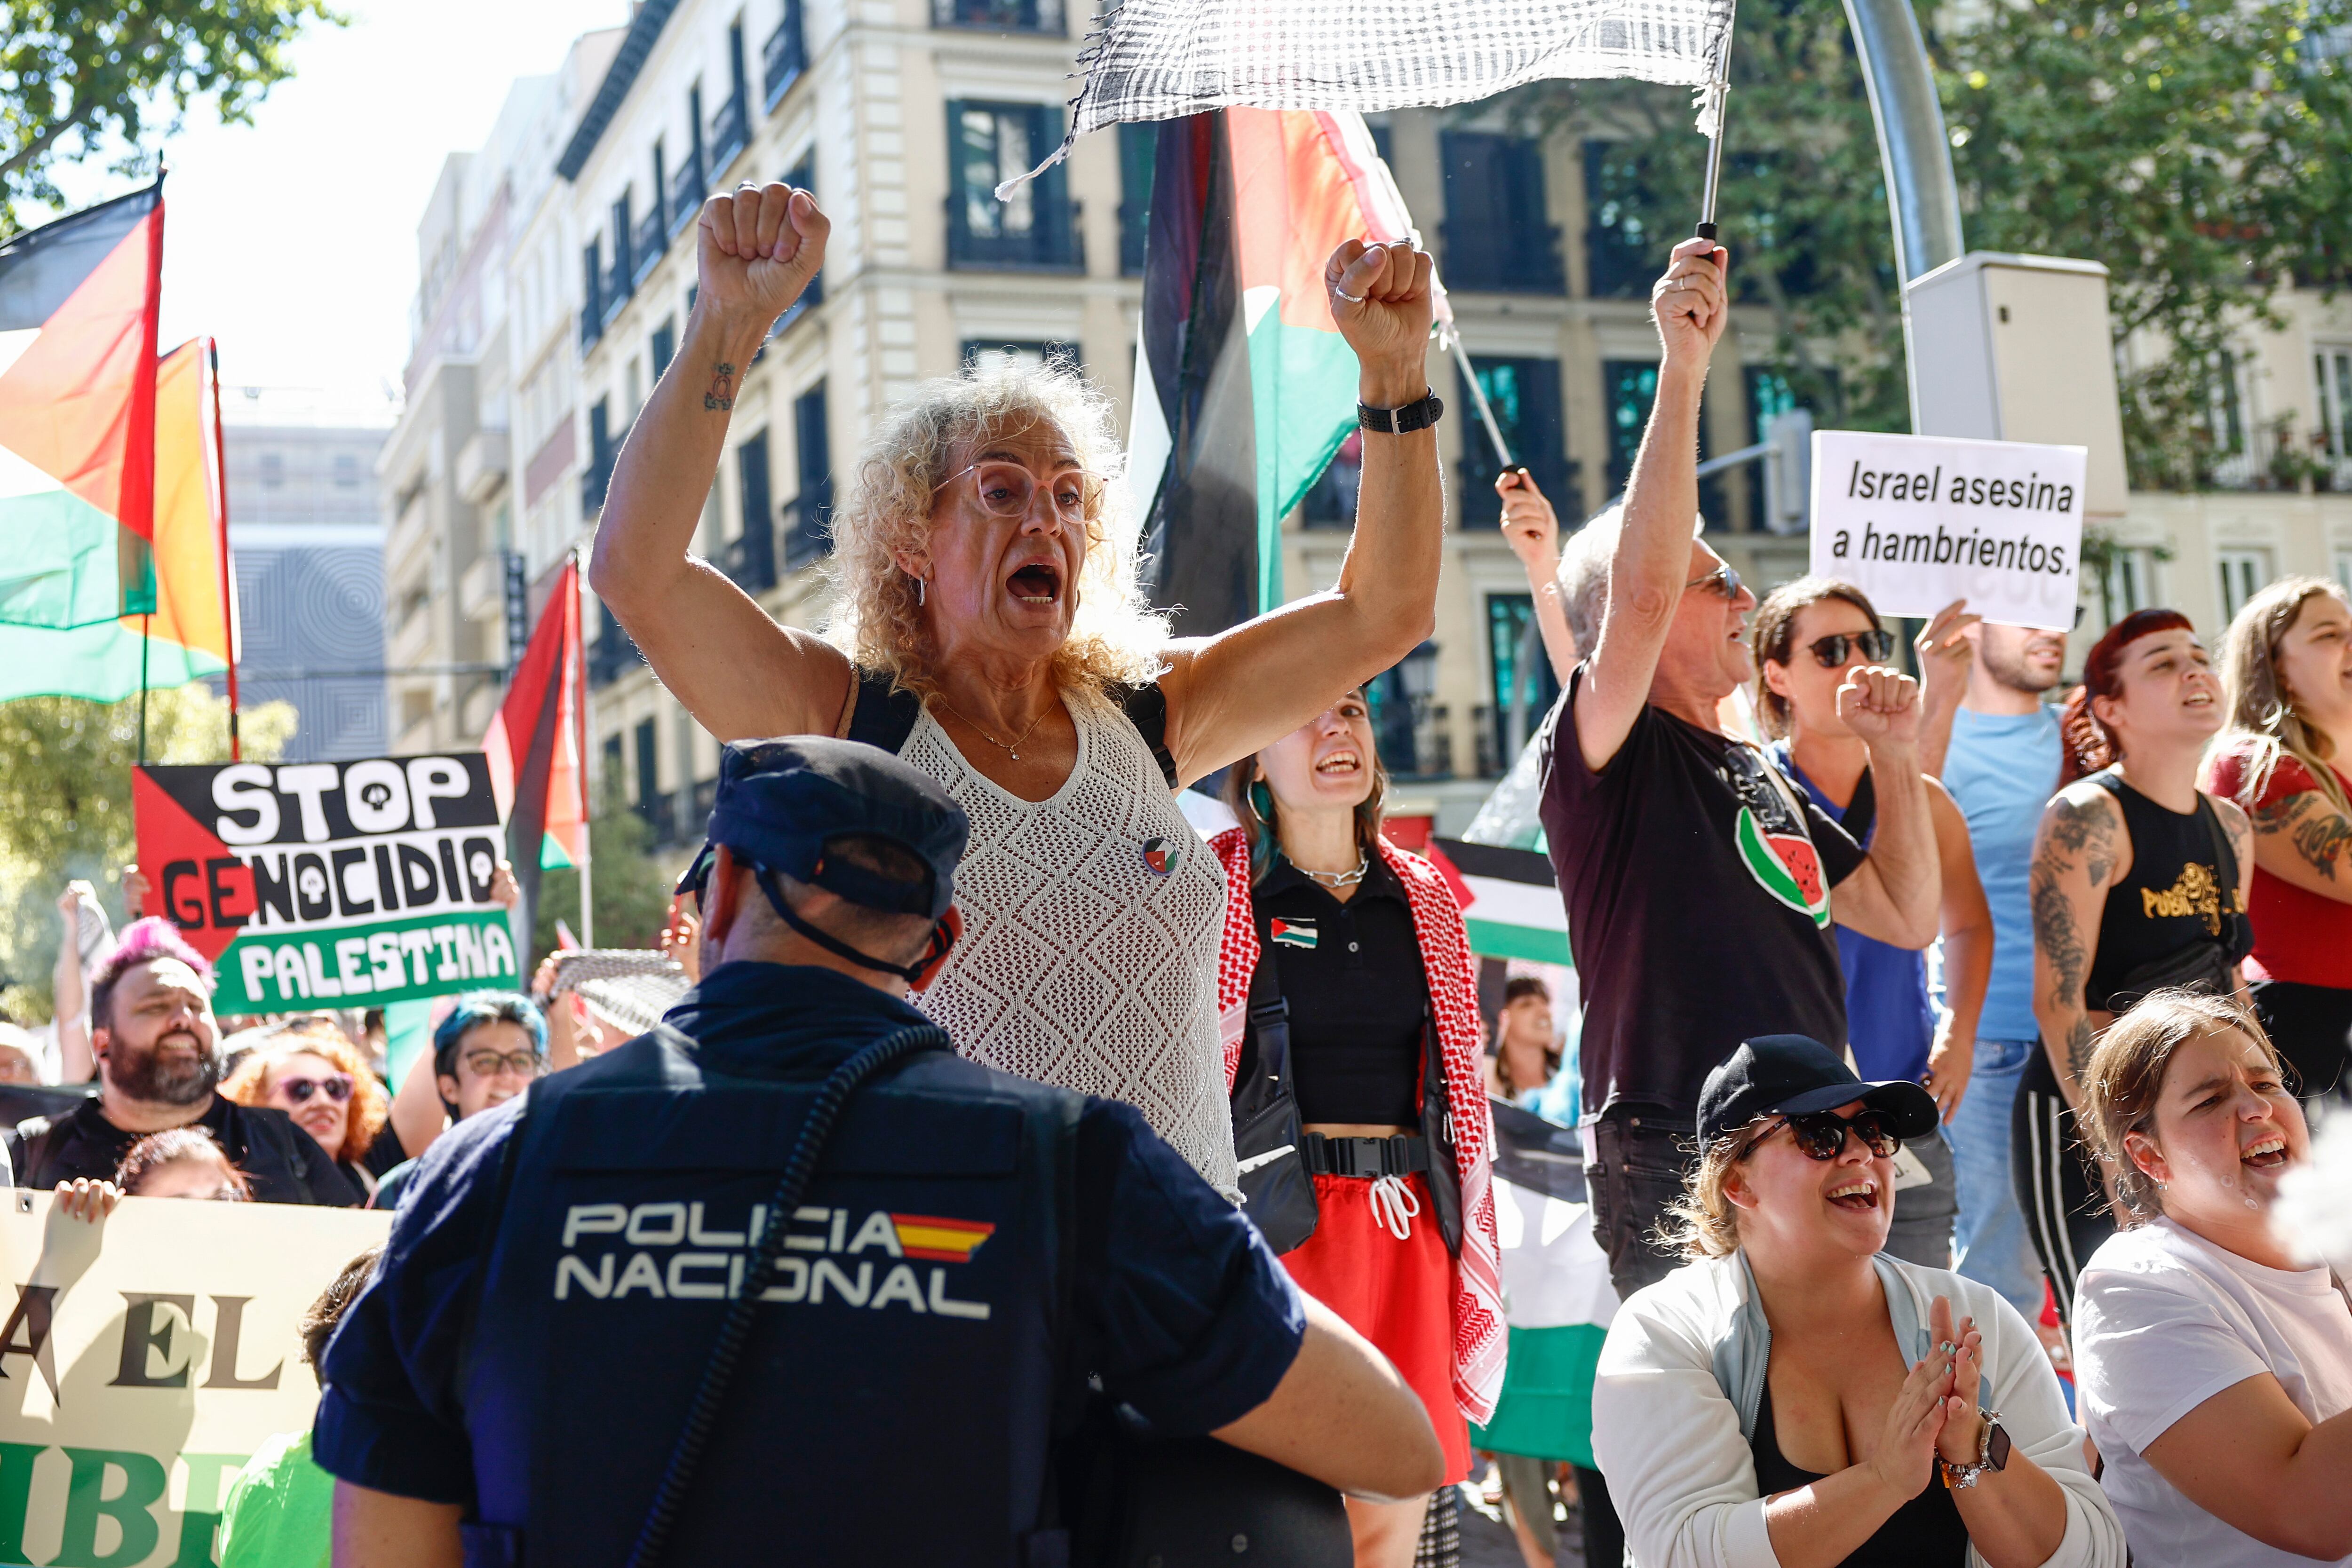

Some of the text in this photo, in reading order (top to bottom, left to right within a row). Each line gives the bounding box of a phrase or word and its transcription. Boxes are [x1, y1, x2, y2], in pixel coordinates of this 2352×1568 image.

[1849, 460, 2074, 513] Israel asesina
[1834, 522, 2072, 575] a hambrientos.
[211, 756, 470, 845] STOP
[162, 837, 496, 928] GENOCIDIO
[239, 923, 516, 1002] PALESTINA
[554, 1251, 991, 1320] NACIONAL
[104, 1291, 285, 1391] EL
